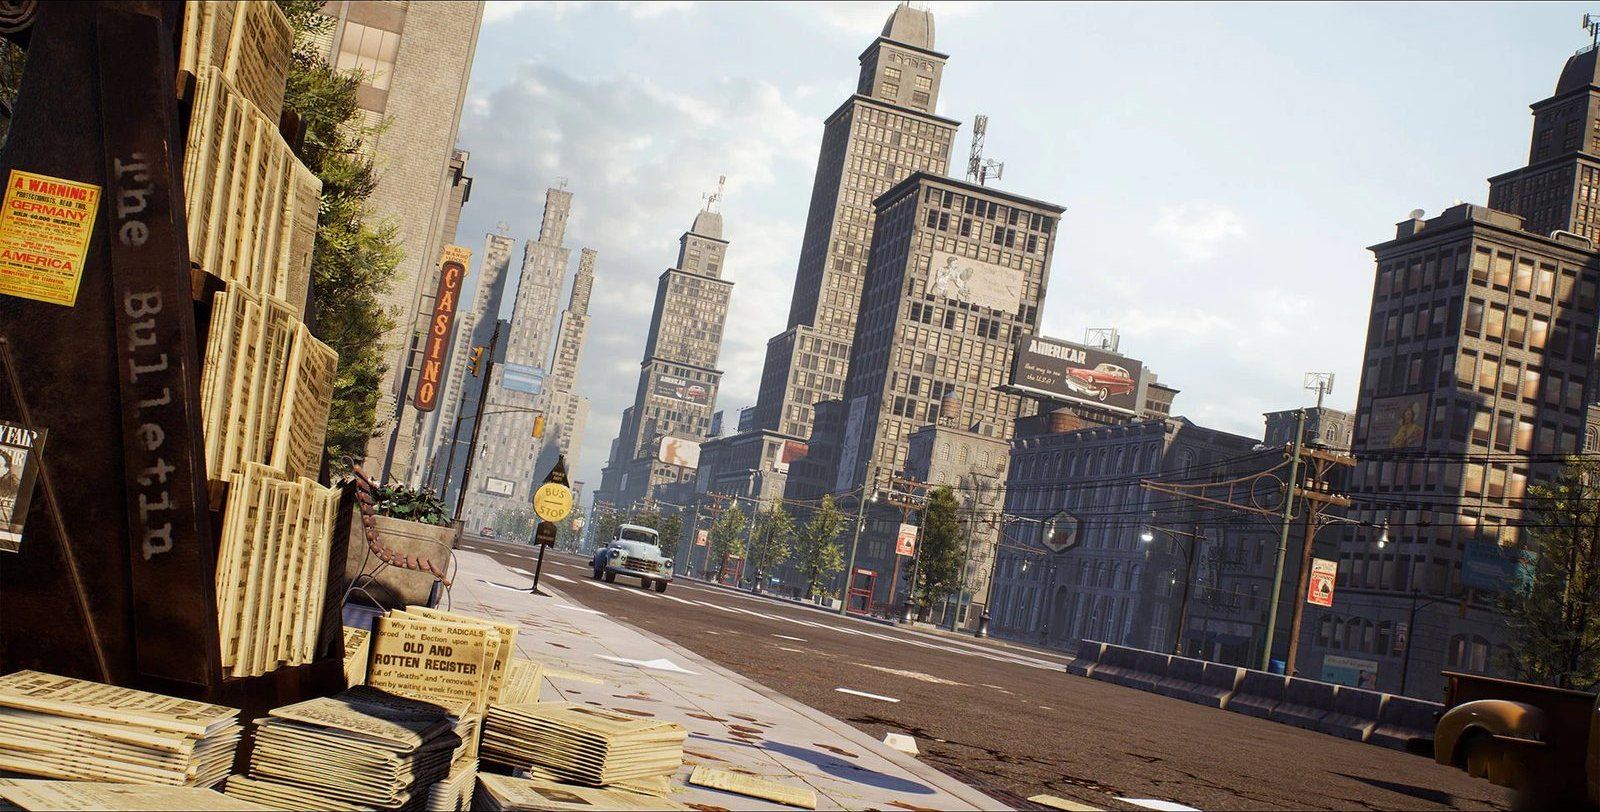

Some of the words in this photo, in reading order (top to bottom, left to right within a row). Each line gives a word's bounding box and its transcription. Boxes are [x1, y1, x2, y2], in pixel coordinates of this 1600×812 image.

[15, 177, 24, 189] A
[114, 152, 155, 248] The
[10, 199, 88, 222] GERMANY
[1, 249, 72, 270] AMERICA
[420, 268, 459, 404] CASINO
[1028, 340, 1087, 365] AMERICAR
[124, 288, 177, 561] Bulletin
[545, 488, 567, 499] BUS
[540, 506, 565, 518] STOP
[391, 621, 406, 631] Why
[410, 624, 427, 632] have
[431, 625, 443, 634] the
[446, 627, 485, 639] RADICALS
[404, 632, 416, 640] the
[420, 633, 448, 644] Election
[451, 639, 469, 647] upon
[403, 642, 424, 654] OLD
[429, 644, 453, 657] AND
[374, 653, 420, 669] ROTTEN
[424, 659, 477, 675] REGISTER
[425, 674, 438, 682] and
[387, 681, 397, 689] by
[397, 683, 422, 692] waiting
[446, 686, 464, 697] from
[465, 690, 477, 698] the
